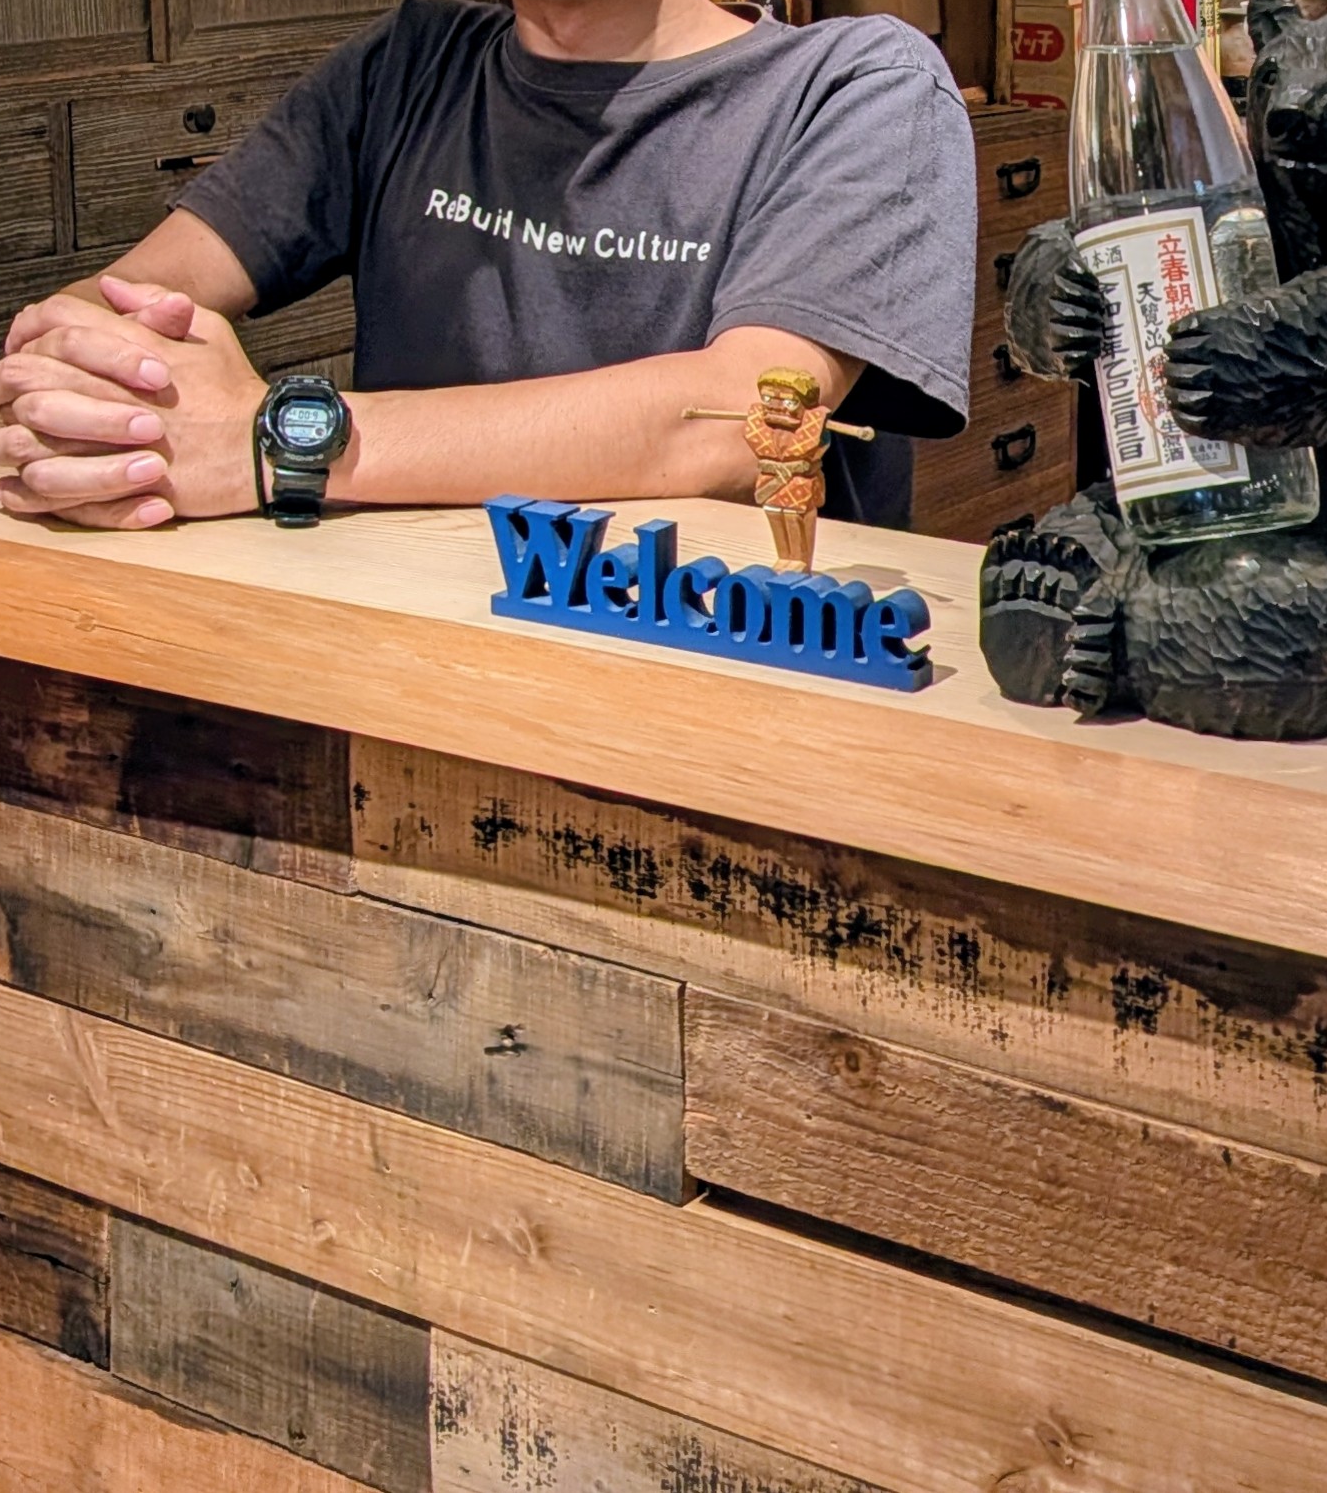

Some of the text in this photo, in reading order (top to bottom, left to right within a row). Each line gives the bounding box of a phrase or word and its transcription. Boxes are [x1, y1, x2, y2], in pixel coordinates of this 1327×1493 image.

[522, 217, 586, 257] New
[594, 227, 711, 263] Culture
[482, 494, 932, 679] Welcome
